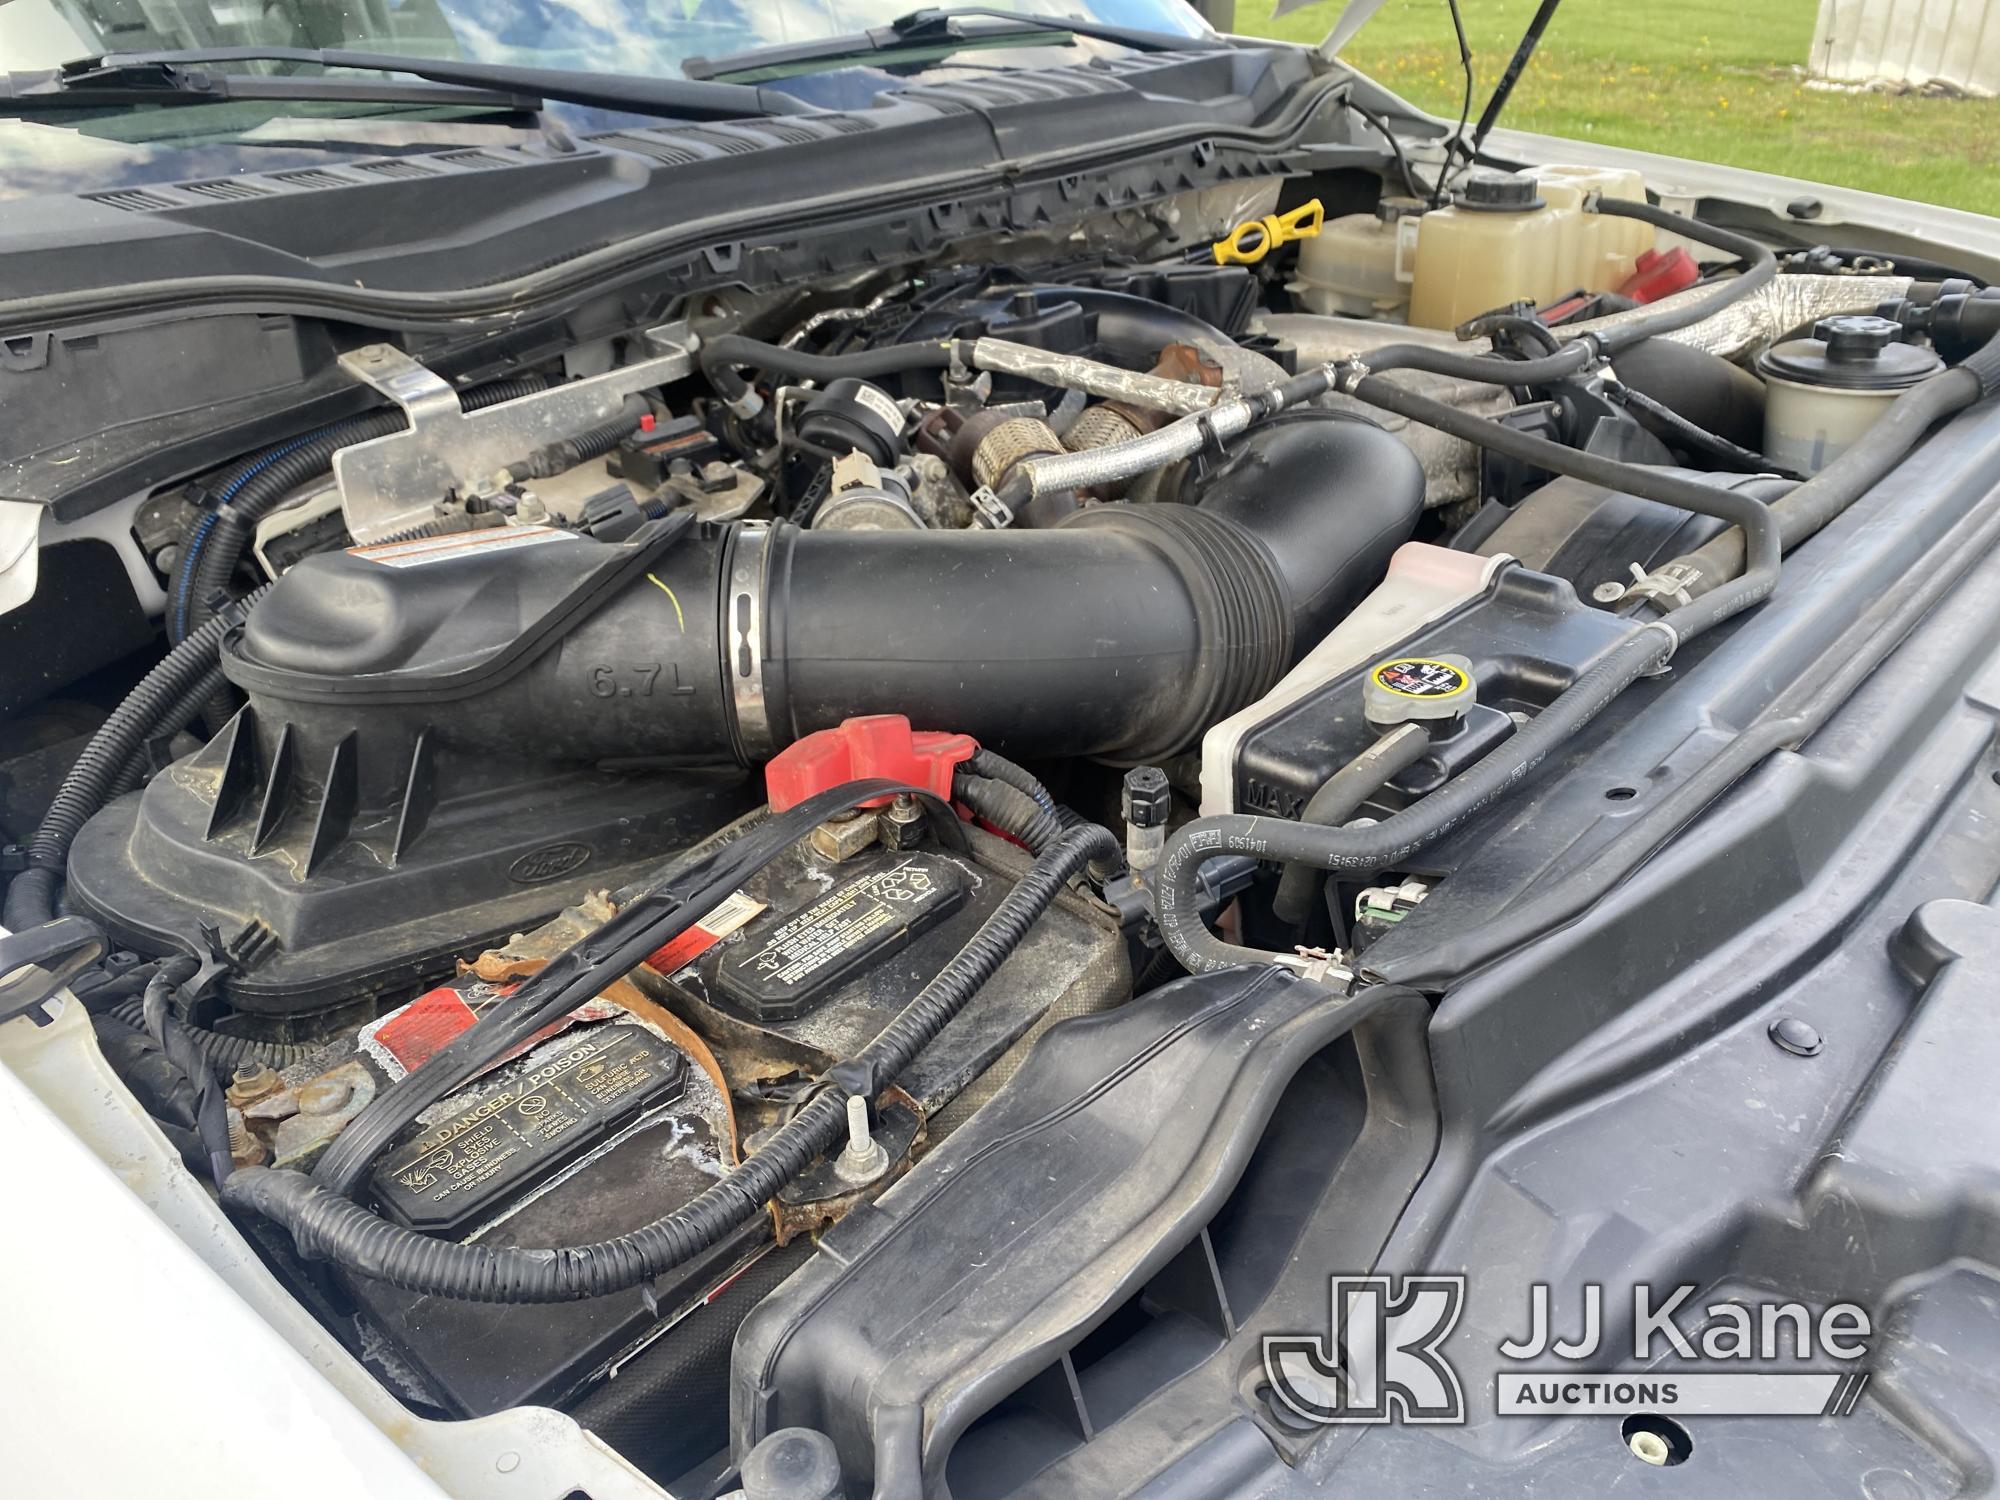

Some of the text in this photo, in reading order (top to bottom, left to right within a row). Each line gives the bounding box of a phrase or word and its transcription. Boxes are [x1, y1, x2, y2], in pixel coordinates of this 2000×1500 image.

[586, 662, 697, 698] 6.7L
[1247, 778, 1304, 821] MAX
[522, 846, 580, 878] Ford
[774, 899, 856, 952] FLUSH EYES IMMEDIATELY
[781, 941, 801, 956] WITH
[824, 918, 839, 928] GET
[787, 917, 851, 960] MEDICAL HELP FAST
[584, 1050, 651, 1091] SULFURIC ACID
[590, 1069, 632, 1095] CAN CAUSE
[595, 1067, 647, 1100] BLINDNESS OR
[434, 1092, 515, 1142] DANGER
[528, 1043, 597, 1086] POISON
[602, 1072, 652, 1105] SEVERE BURNS
[535, 1109, 551, 1121] NO
[457, 1125, 494, 1149] SHIELD
[463, 1137, 491, 1156] EYES
[446, 1137, 502, 1175] EXPLOSIVE
[453, 1157, 489, 1180] GASES
[433, 1189, 451, 1202] CAN
[450, 1174, 477, 1191] CAUSE
[463, 1165, 503, 1192] OR INJURY
